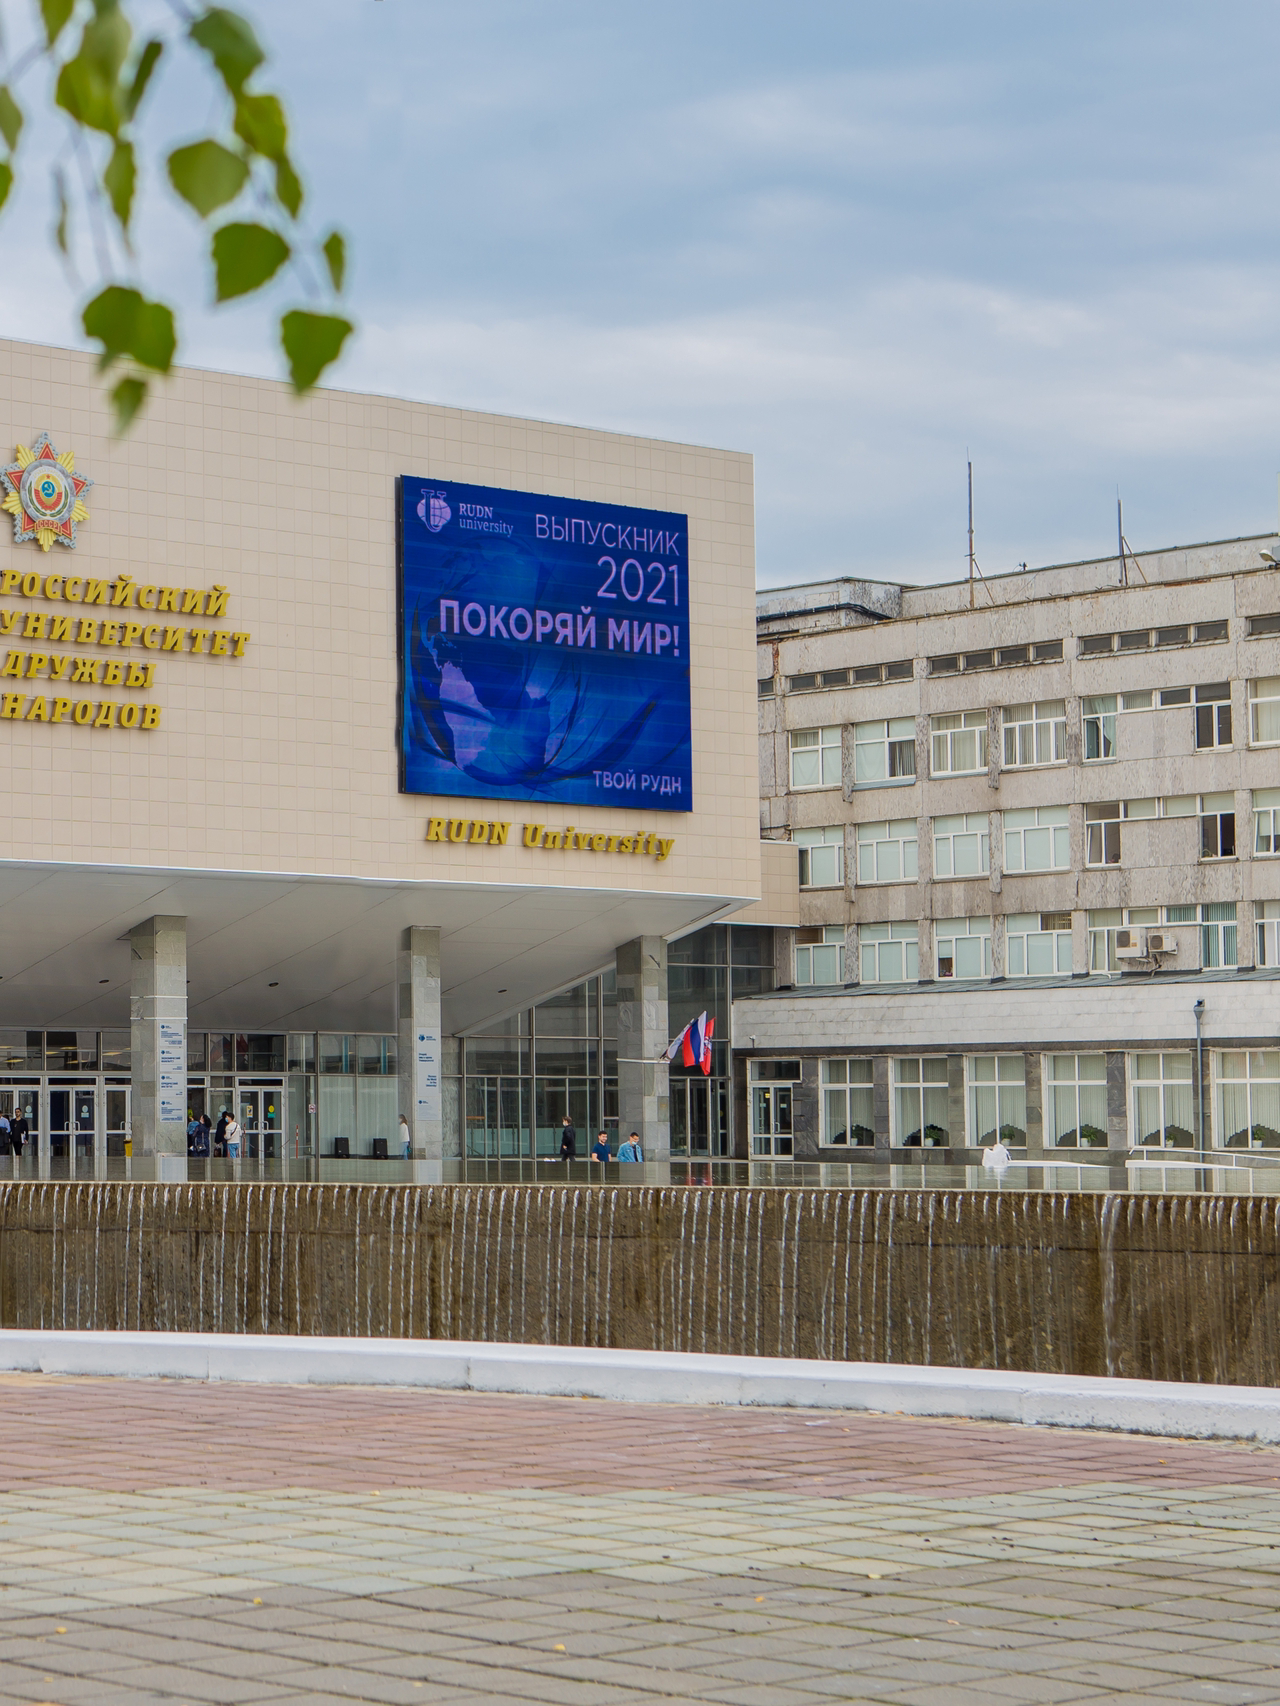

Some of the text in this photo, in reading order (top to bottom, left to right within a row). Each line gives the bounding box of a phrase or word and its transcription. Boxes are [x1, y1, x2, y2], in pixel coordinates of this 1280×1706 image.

[40, 520, 58, 529] СССР
[459, 503, 493, 519] RUDN
[459, 517, 514, 537] university
[535, 513, 680, 556] ВЫПУСКНИК
[0, 569, 231, 616] РОССИЙСКИЙ
[597, 556, 679, 606] 2021
[0, 609, 251, 656] УНИВЕРСИТЕТ
[440, 599, 680, 657] ПОКОРЯЙ МИР!
[0, 650, 157, 688] ДРУЖБЫ
[0, 692, 163, 729] НАРОДОВ
[593, 769, 682, 796] ТВОЙ РУДН
[426, 817, 675, 861] RUDN University
